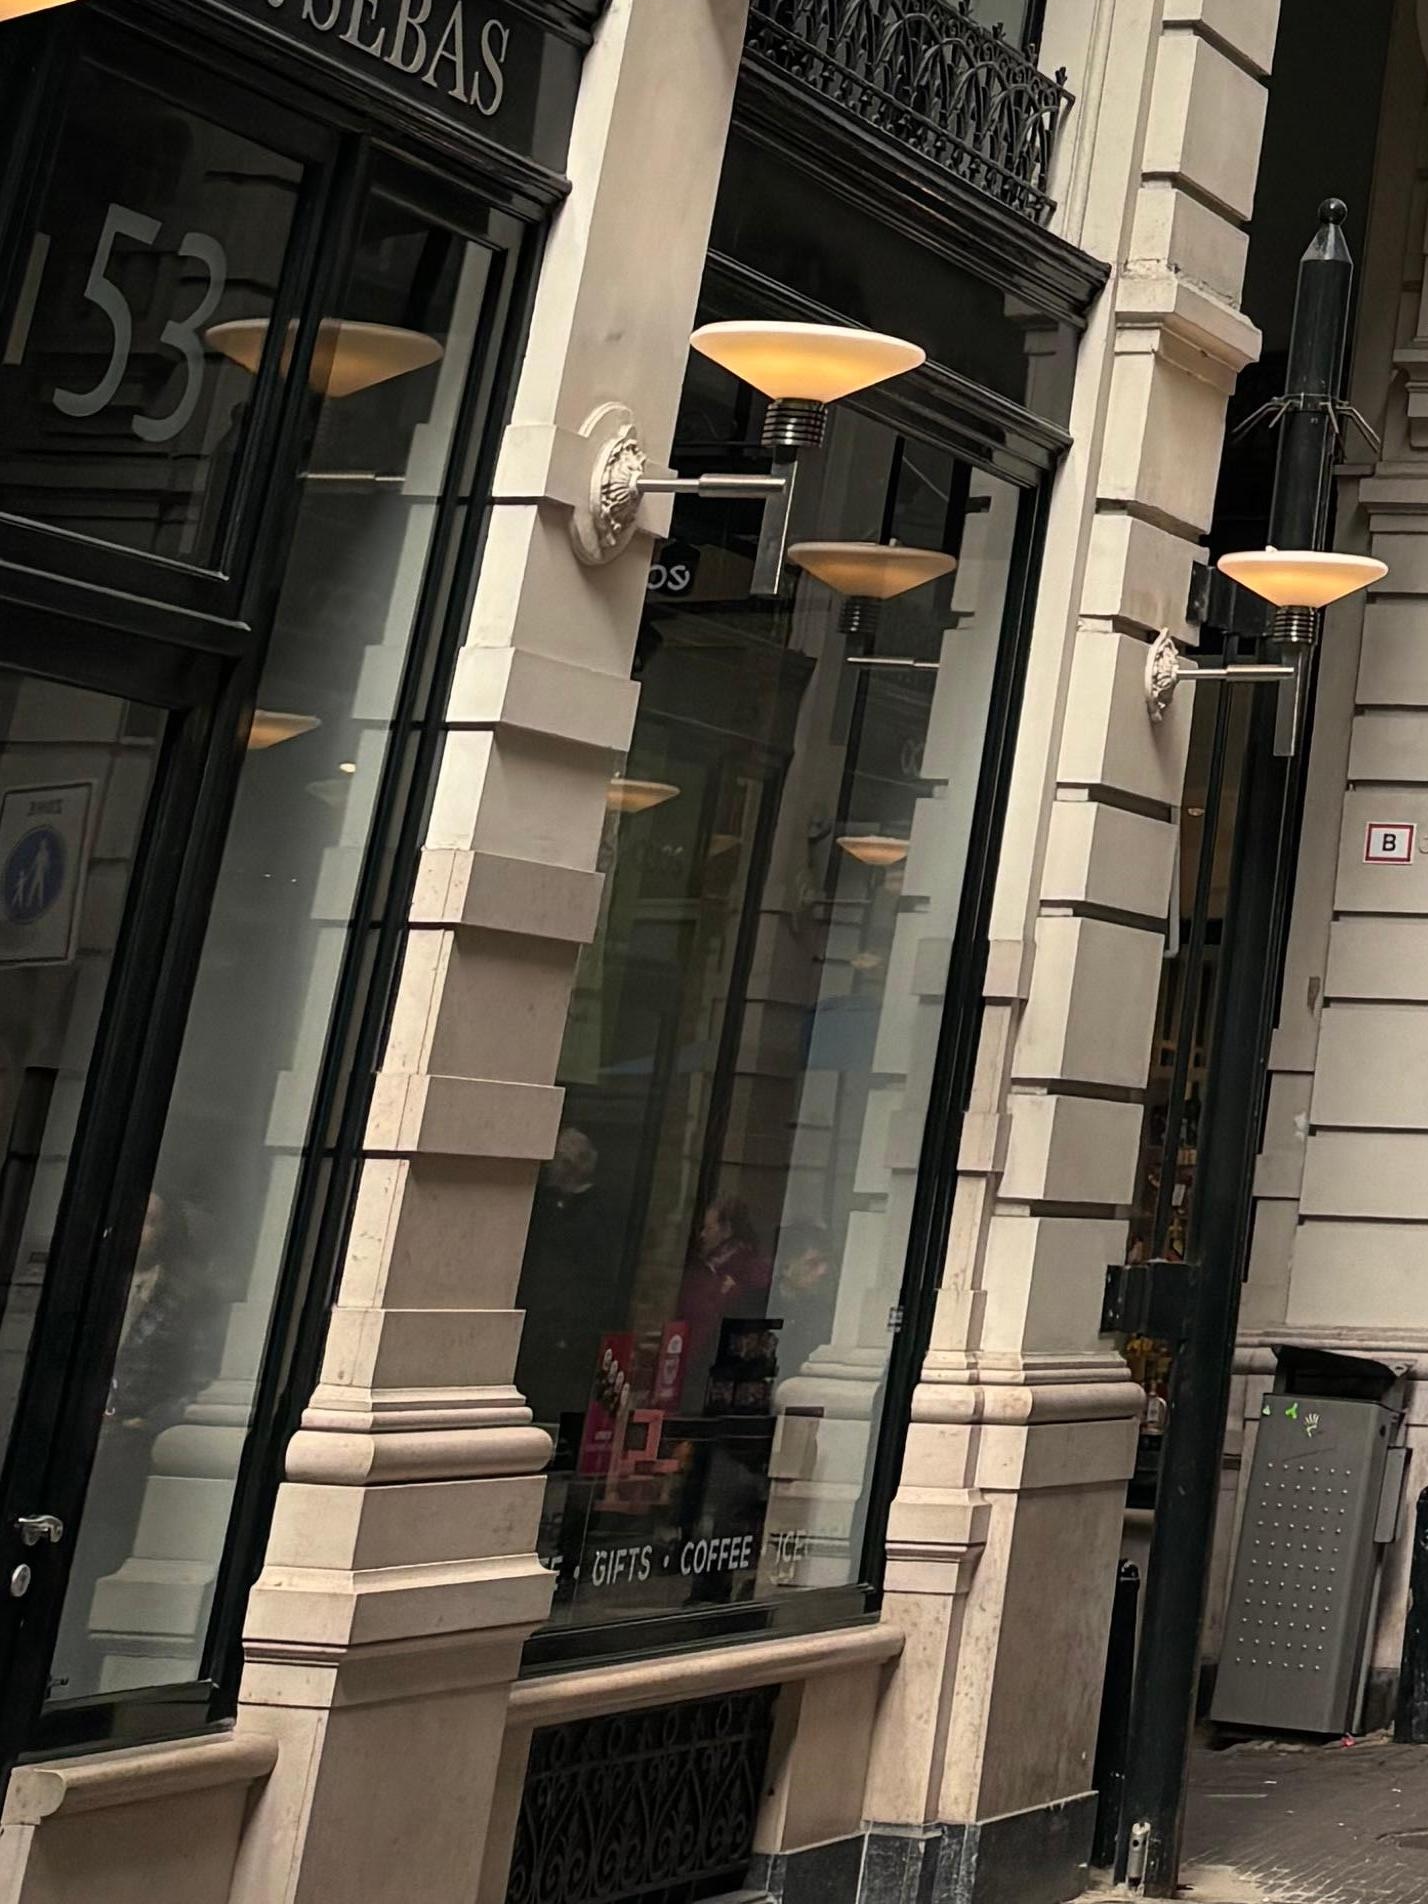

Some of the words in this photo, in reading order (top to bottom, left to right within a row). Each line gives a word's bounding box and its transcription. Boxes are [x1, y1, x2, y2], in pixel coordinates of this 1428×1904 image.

[53, 203, 226, 442] 53
[1382, 833, 1396, 852] B
[591, 1545, 653, 1587] GIFTS
[680, 1535, 753, 1576] COFFEE
